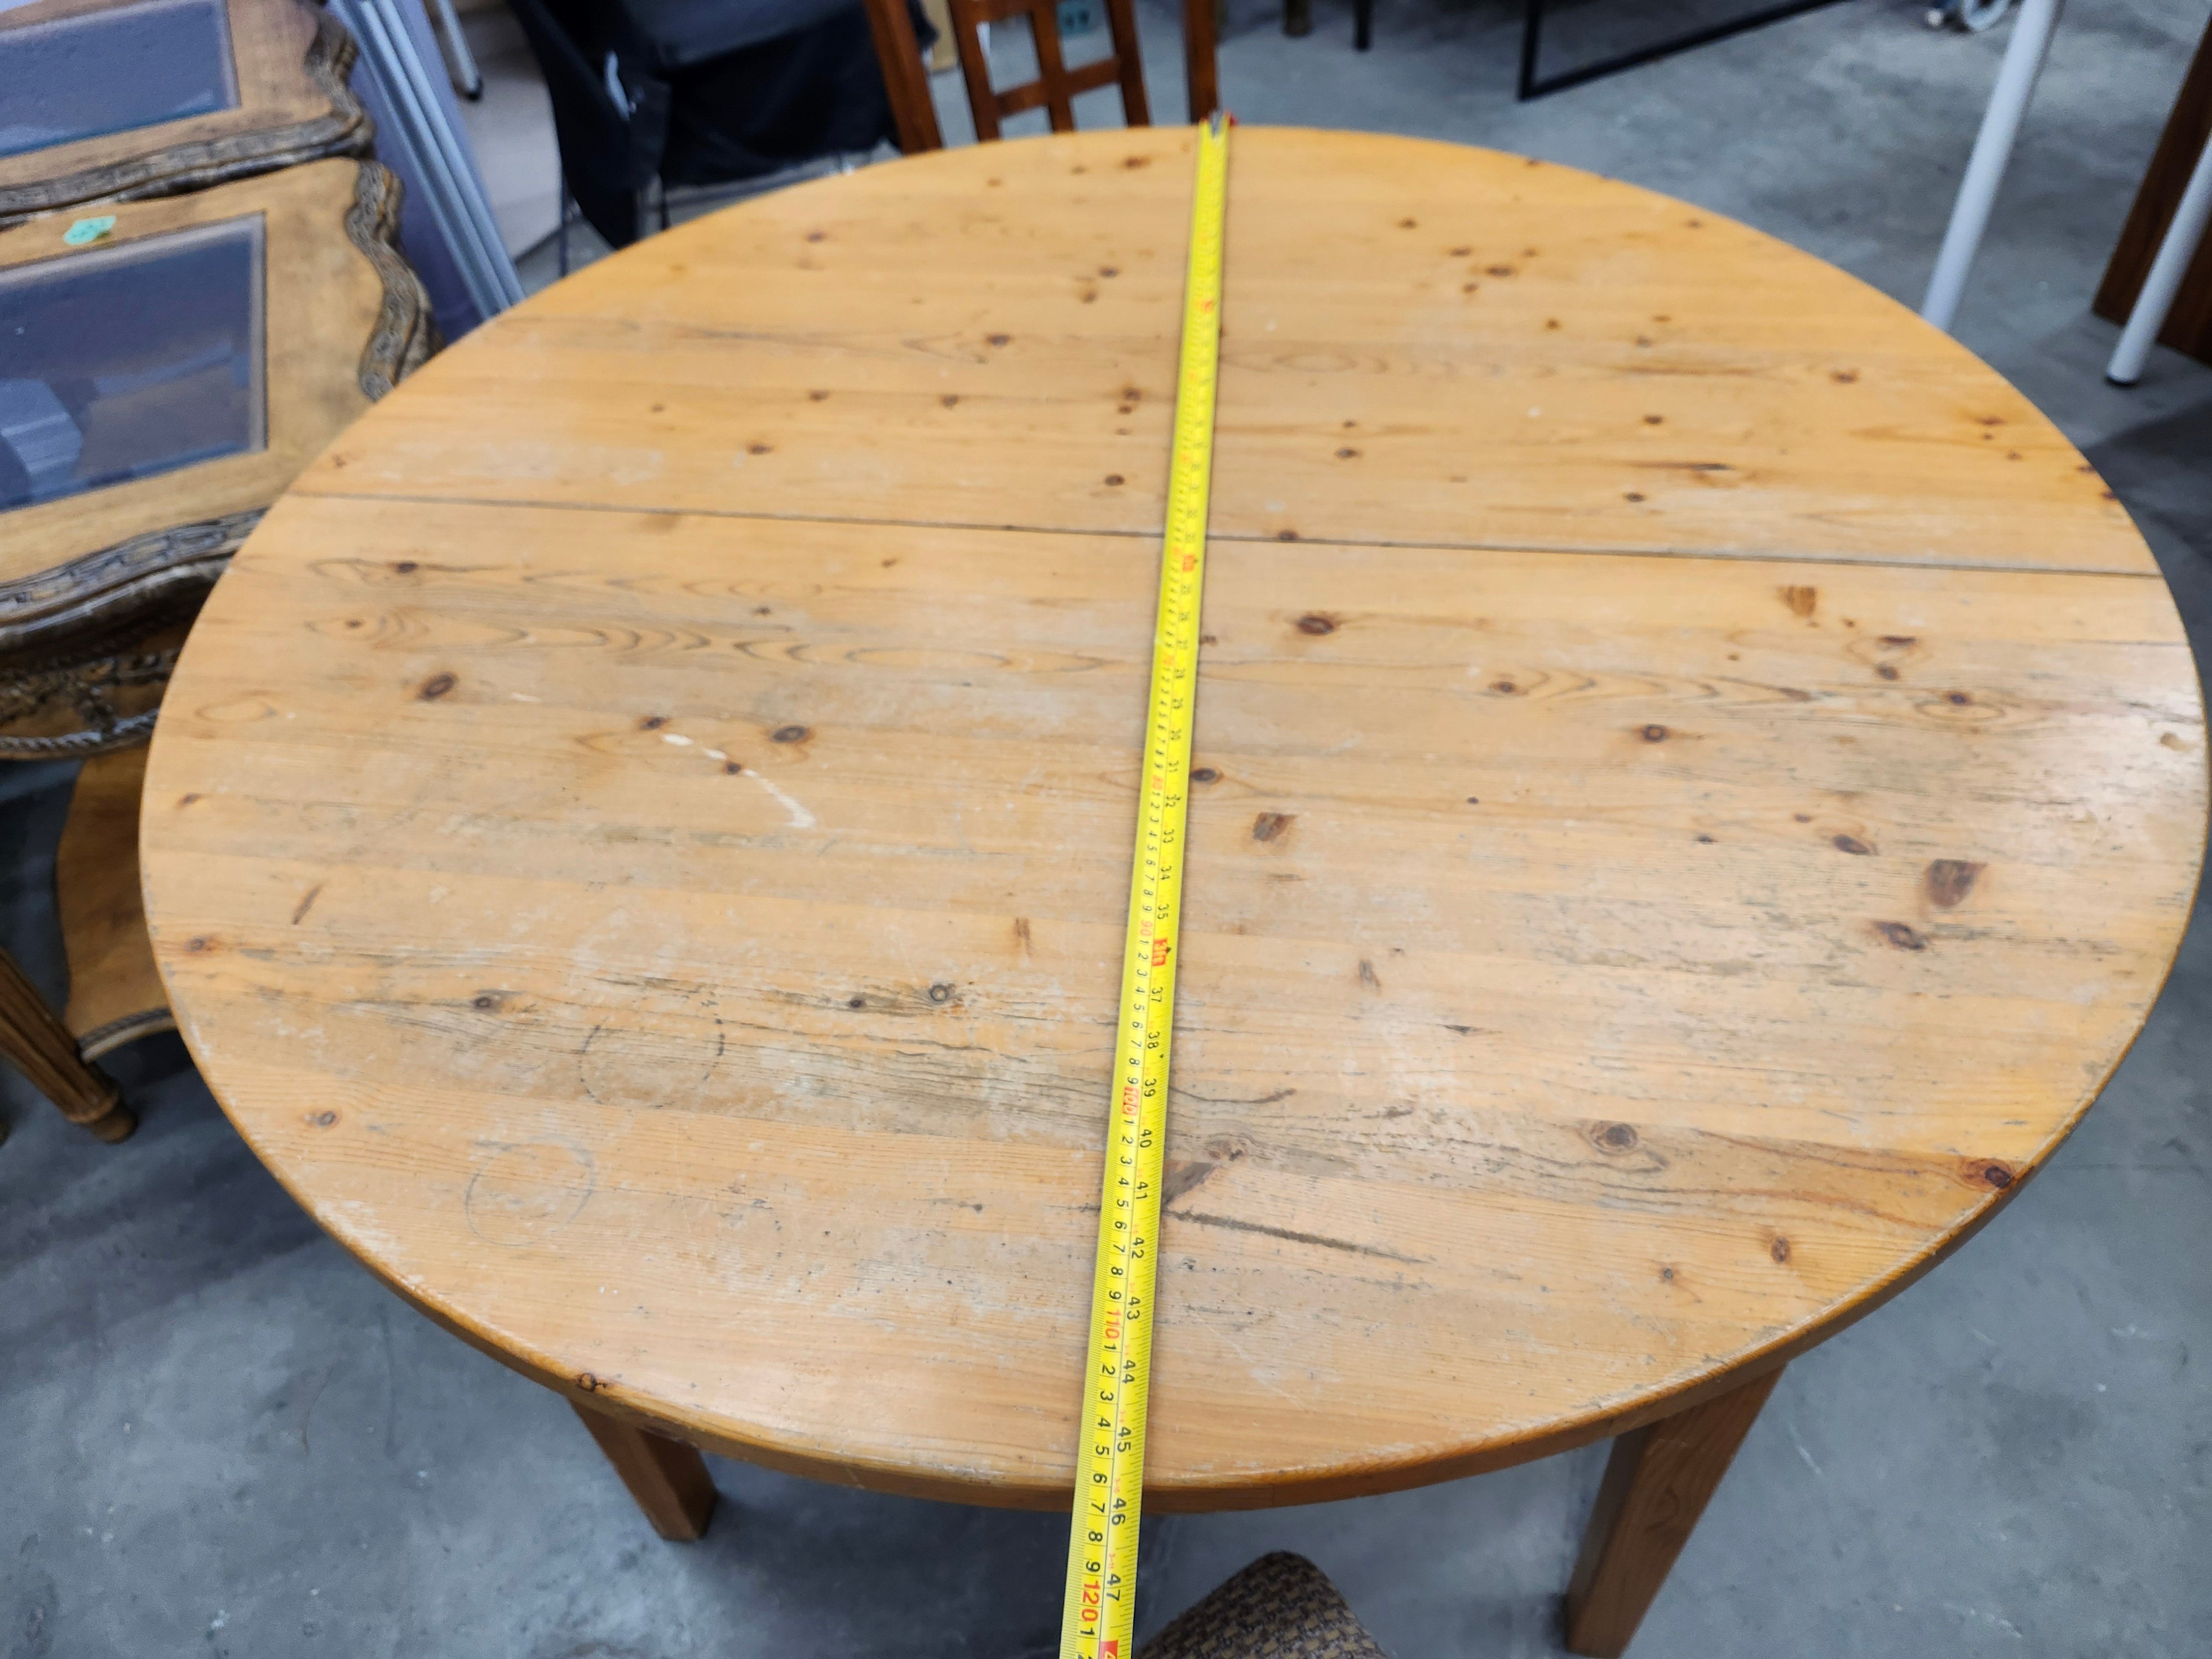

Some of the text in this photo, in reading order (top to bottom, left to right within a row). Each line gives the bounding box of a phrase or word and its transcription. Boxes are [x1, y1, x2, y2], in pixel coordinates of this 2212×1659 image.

[1163, 829, 1174, 843] 33
[1161, 865, 1171, 880] 34
[1157, 904, 1169, 920] 35
[1140, 920, 1152, 937] 90
[1151, 987, 1163, 1003] 37
[1147, 1031, 1160, 1049] 38
[1127, 1076, 1139, 1084] 9
[1144, 1078, 1156, 1097] 39
[1123, 1087, 1139, 1115] 100
[1121, 1136, 1134, 1145] 2
[1140, 1129, 1152, 1148] 40
[1120, 1156, 1133, 1165] 3
[1118, 1177, 1130, 1186] 4
[1136, 1181, 1149, 1199] 41
[1117, 1199, 1129, 1207] 5
[1115, 1221, 1127, 1230] 6
[1113, 1244, 1125, 1253] 7
[1131, 1237, 1144, 1259] 42
[1111, 1266, 1123, 1276] 8
[1109, 1291, 1121, 1300] 9
[1126, 1296, 1141, 1320] 43
[1105, 1308, 1121, 1339] 110
[1102, 1365, 1115, 1375] 2
[1121, 1360, 1136, 1384] 44
[1100, 1391, 1114, 1401] 3
[1098, 1417, 1111, 1428] 4
[1117, 1426, 1131, 1453] 45
[1095, 1446, 1109, 1455] 5
[1093, 1473, 1107, 1483] 6
[1091, 1503, 1105, 1514] 7
[1111, 1498, 1126, 1526] 46
[1088, 1531, 1103, 1542] 8
[1086, 1561, 1100, 1572] 9
[1106, 1573, 1121, 1601] 47
[1082, 1580, 1100, 1622] 120
[1080, 1627, 1094, 1636] 1
